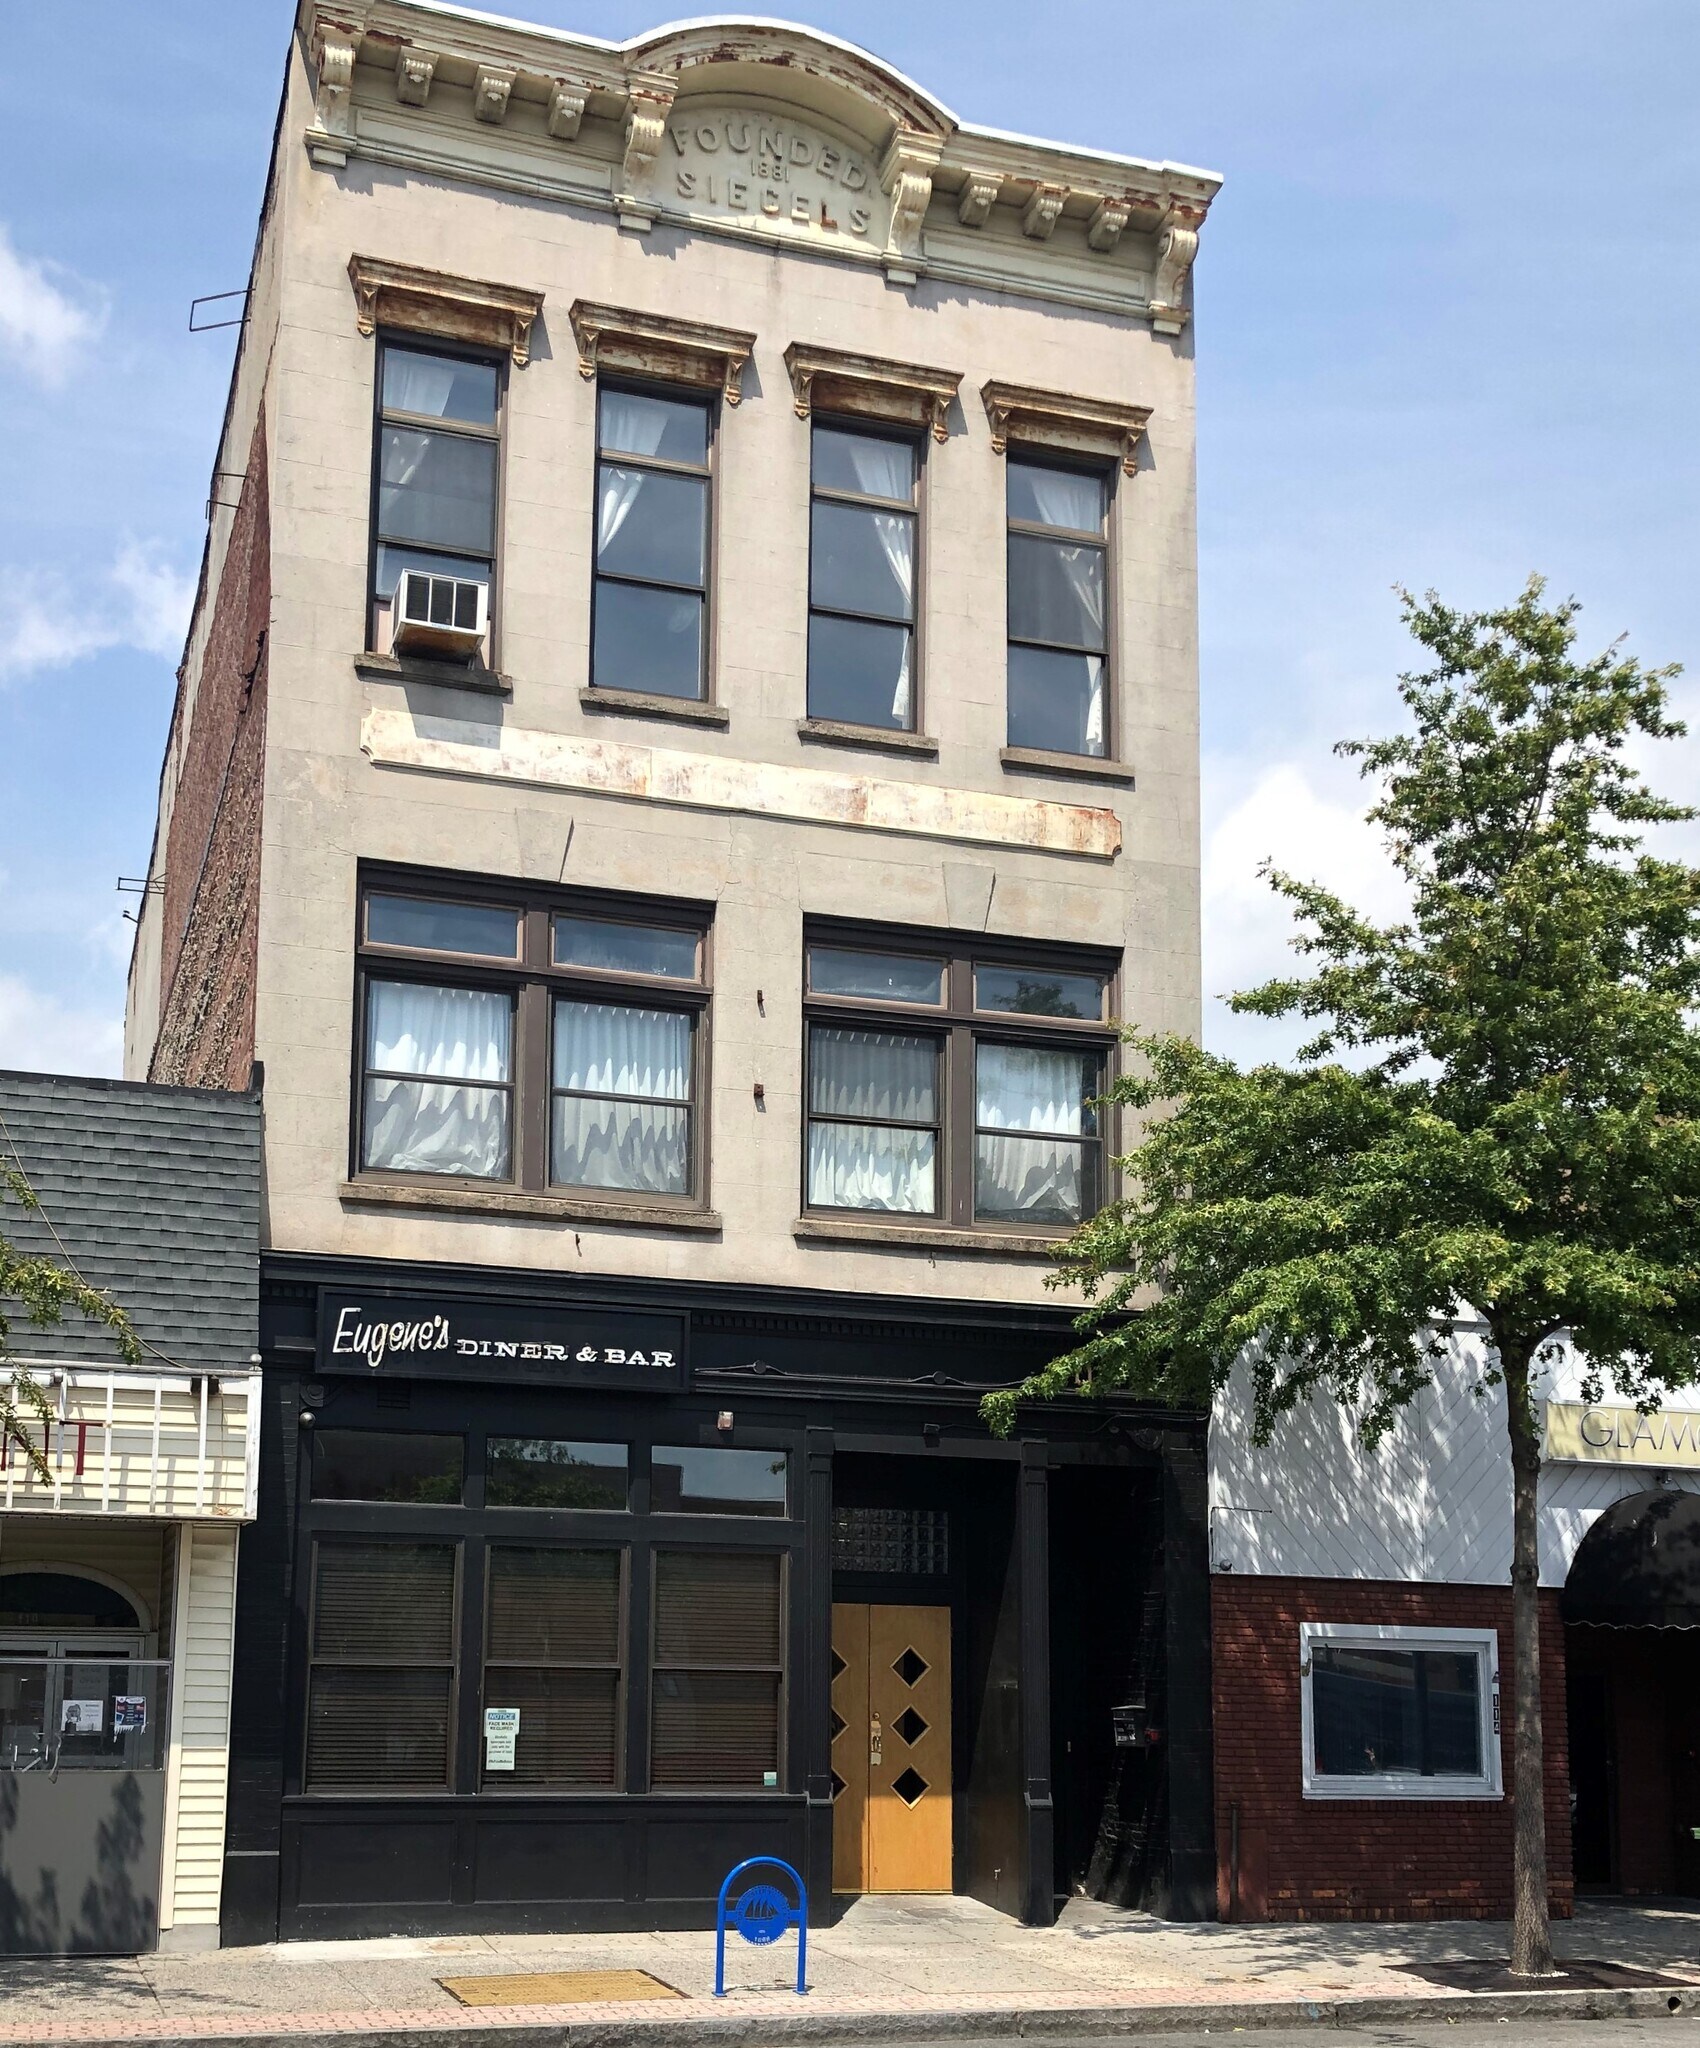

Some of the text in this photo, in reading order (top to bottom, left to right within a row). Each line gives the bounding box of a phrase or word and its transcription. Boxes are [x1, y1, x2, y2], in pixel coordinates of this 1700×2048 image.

[669, 123, 867, 191] FOUNDED
[751, 158, 789, 183] 1881
[677, 170, 872, 234] SIEGELS
[332, 1307, 676, 1368] Eugene's DINER & BAR
[1580, 1409, 1700, 1453] GLAM
